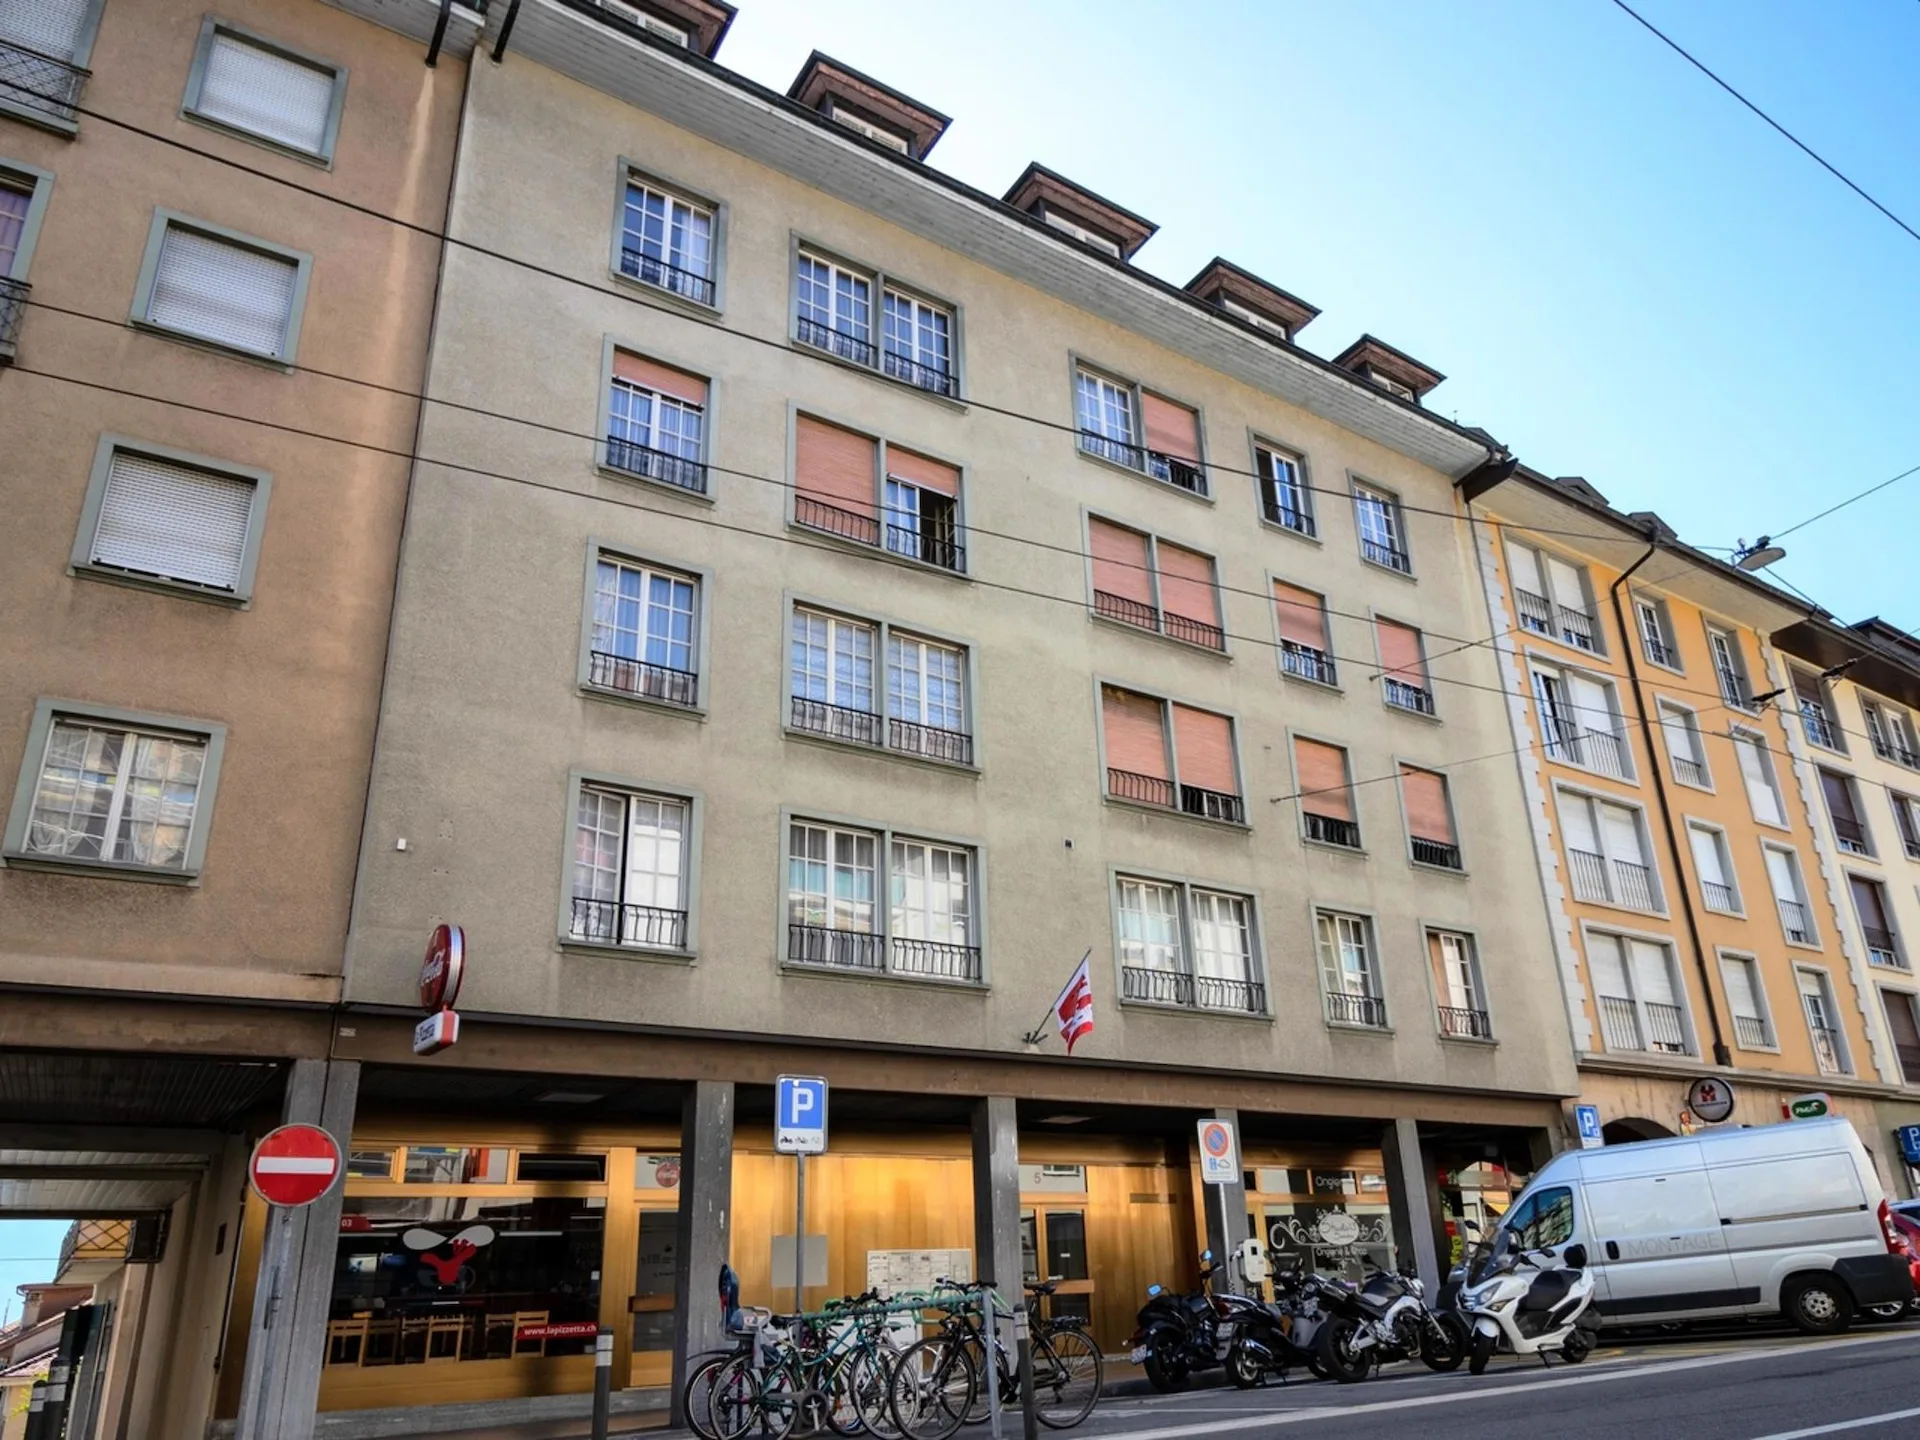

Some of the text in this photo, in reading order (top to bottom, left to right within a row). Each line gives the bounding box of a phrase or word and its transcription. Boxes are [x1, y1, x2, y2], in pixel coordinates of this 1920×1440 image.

[792, 1087, 814, 1124] P
[1583, 1112, 1594, 1135] P
[1034, 1172, 1042, 1184] 5
[1627, 1232, 1719, 1256] MONTAGE
[524, 1323, 597, 1336] www.lapizzetta.ch
